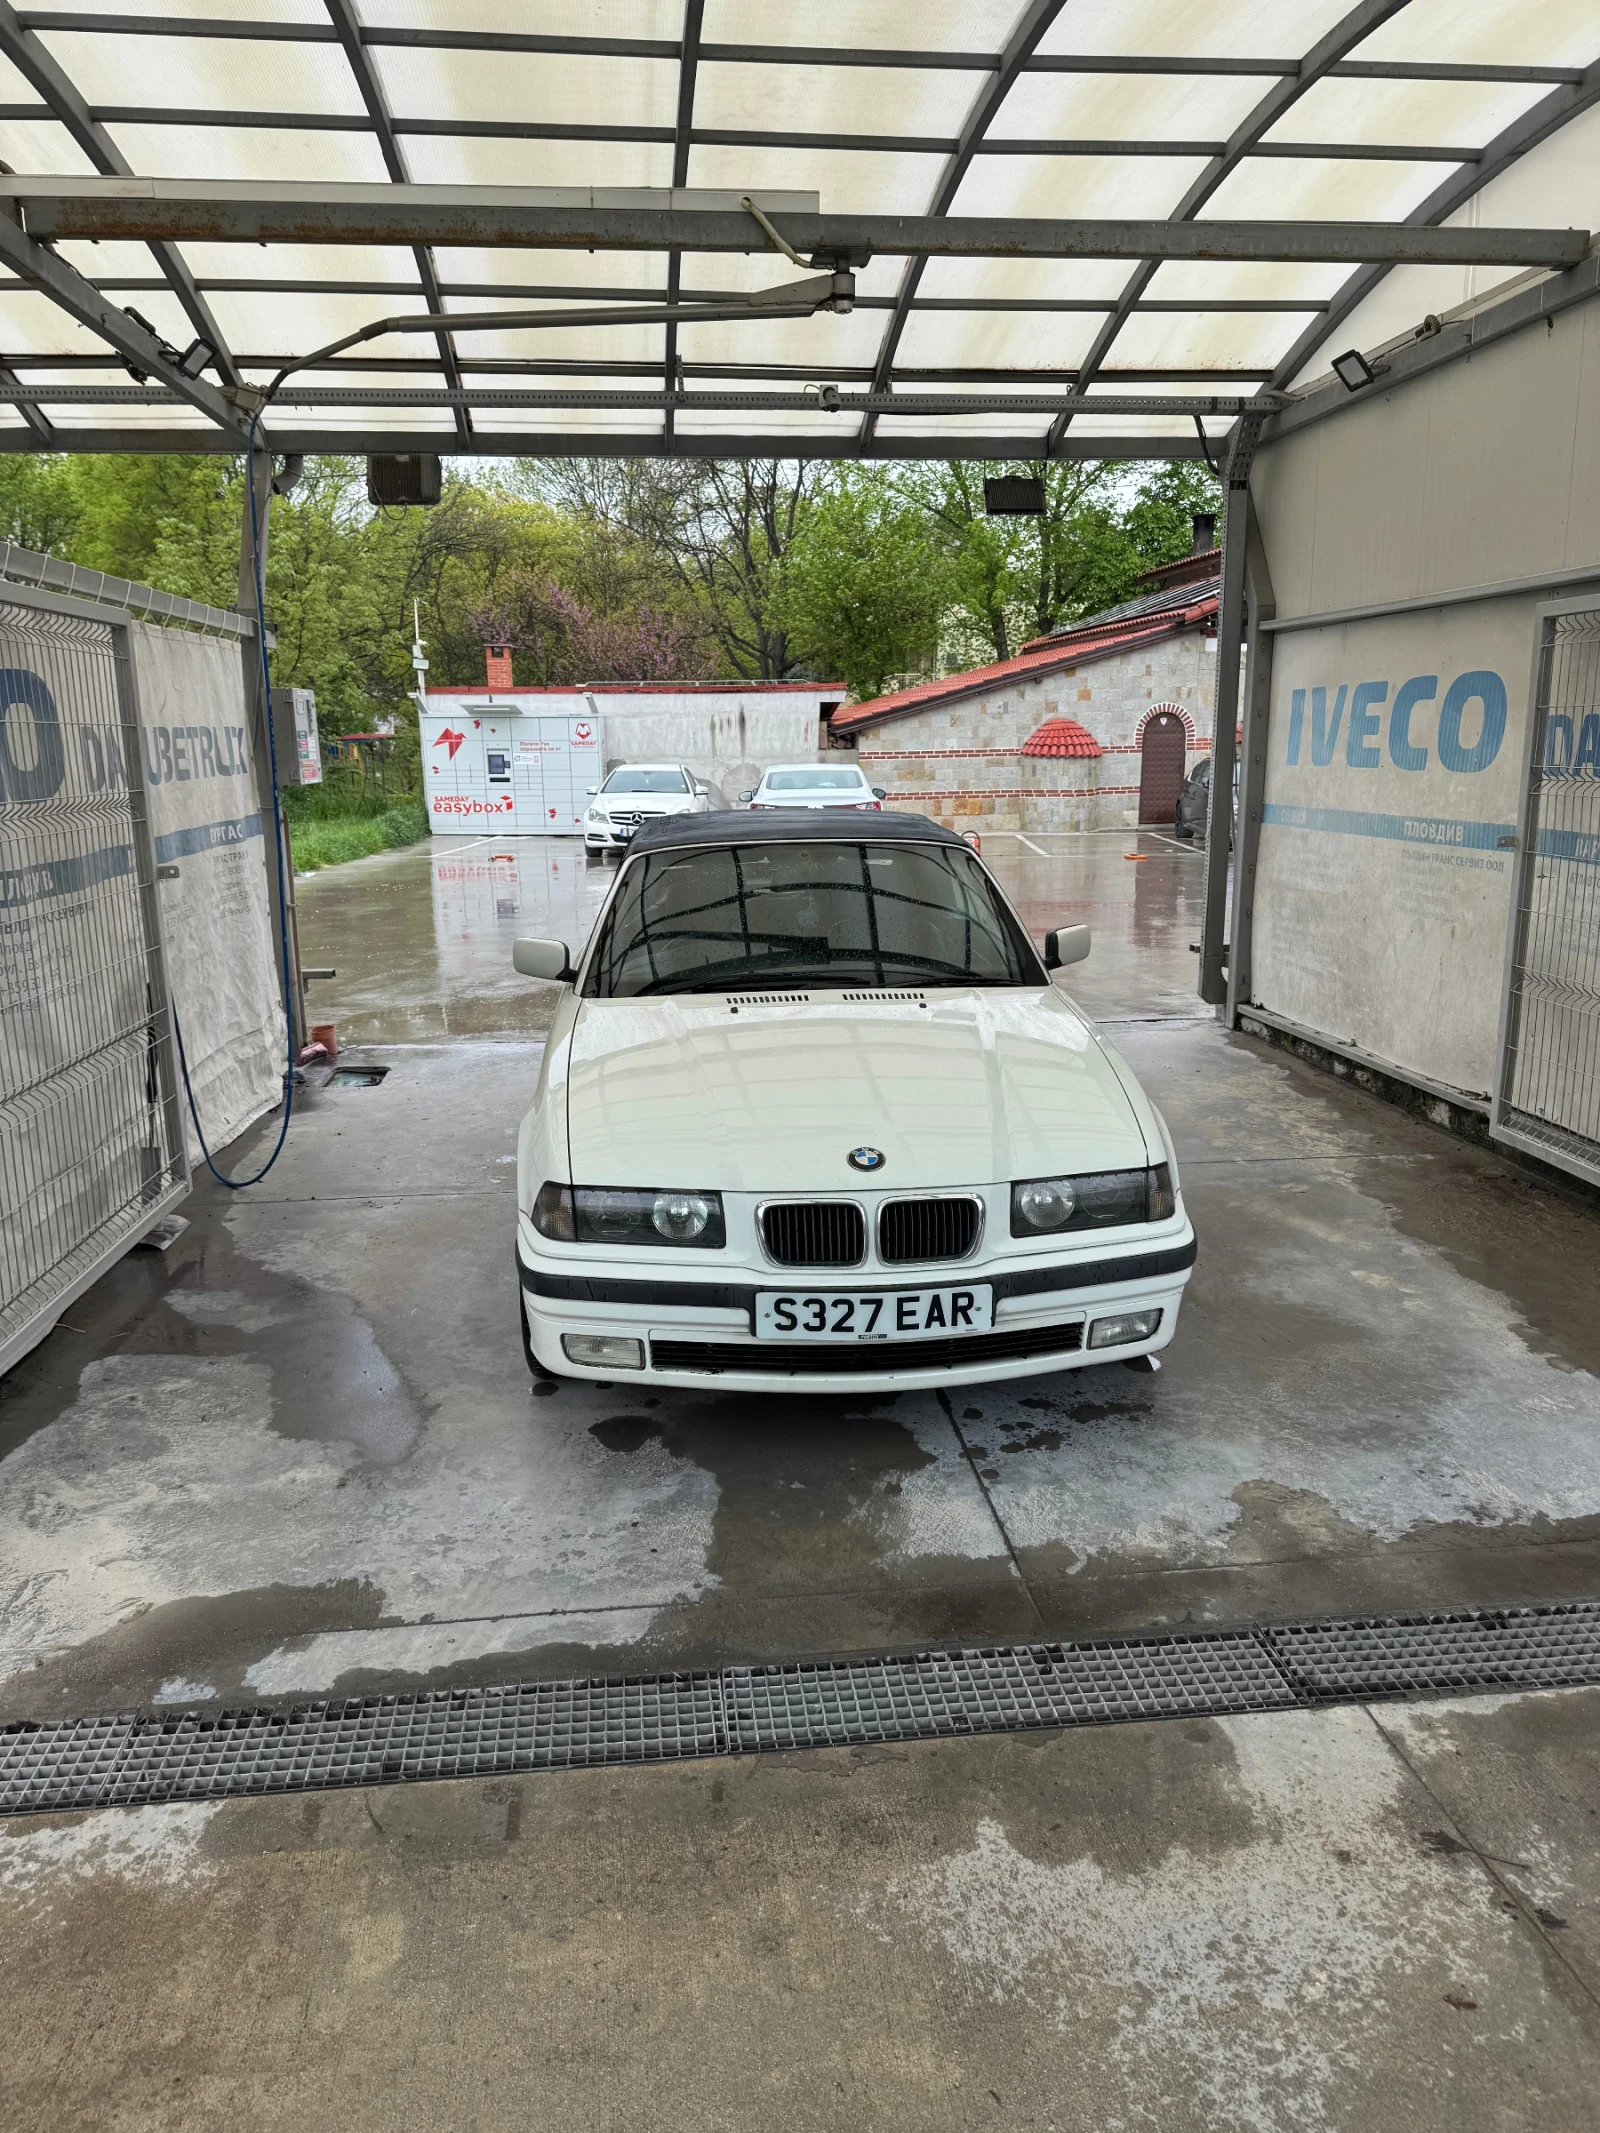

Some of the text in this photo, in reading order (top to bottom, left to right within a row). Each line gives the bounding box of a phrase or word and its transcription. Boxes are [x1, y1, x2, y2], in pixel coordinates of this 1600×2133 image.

[1286, 670, 1507, 773] IVECO
[433, 799, 503, 817] easybox
[434, 795, 469, 803] SAMEDAY
[1404, 821, 1464, 843] ПЛОВДИВ
[1431, 852, 1455, 866] ТРАНС
[1456, 857, 1484, 870] СЕРВИЗ
[1486, 860, 1504, 873] ООД
[774, 1291, 974, 1333] S327 EAR
